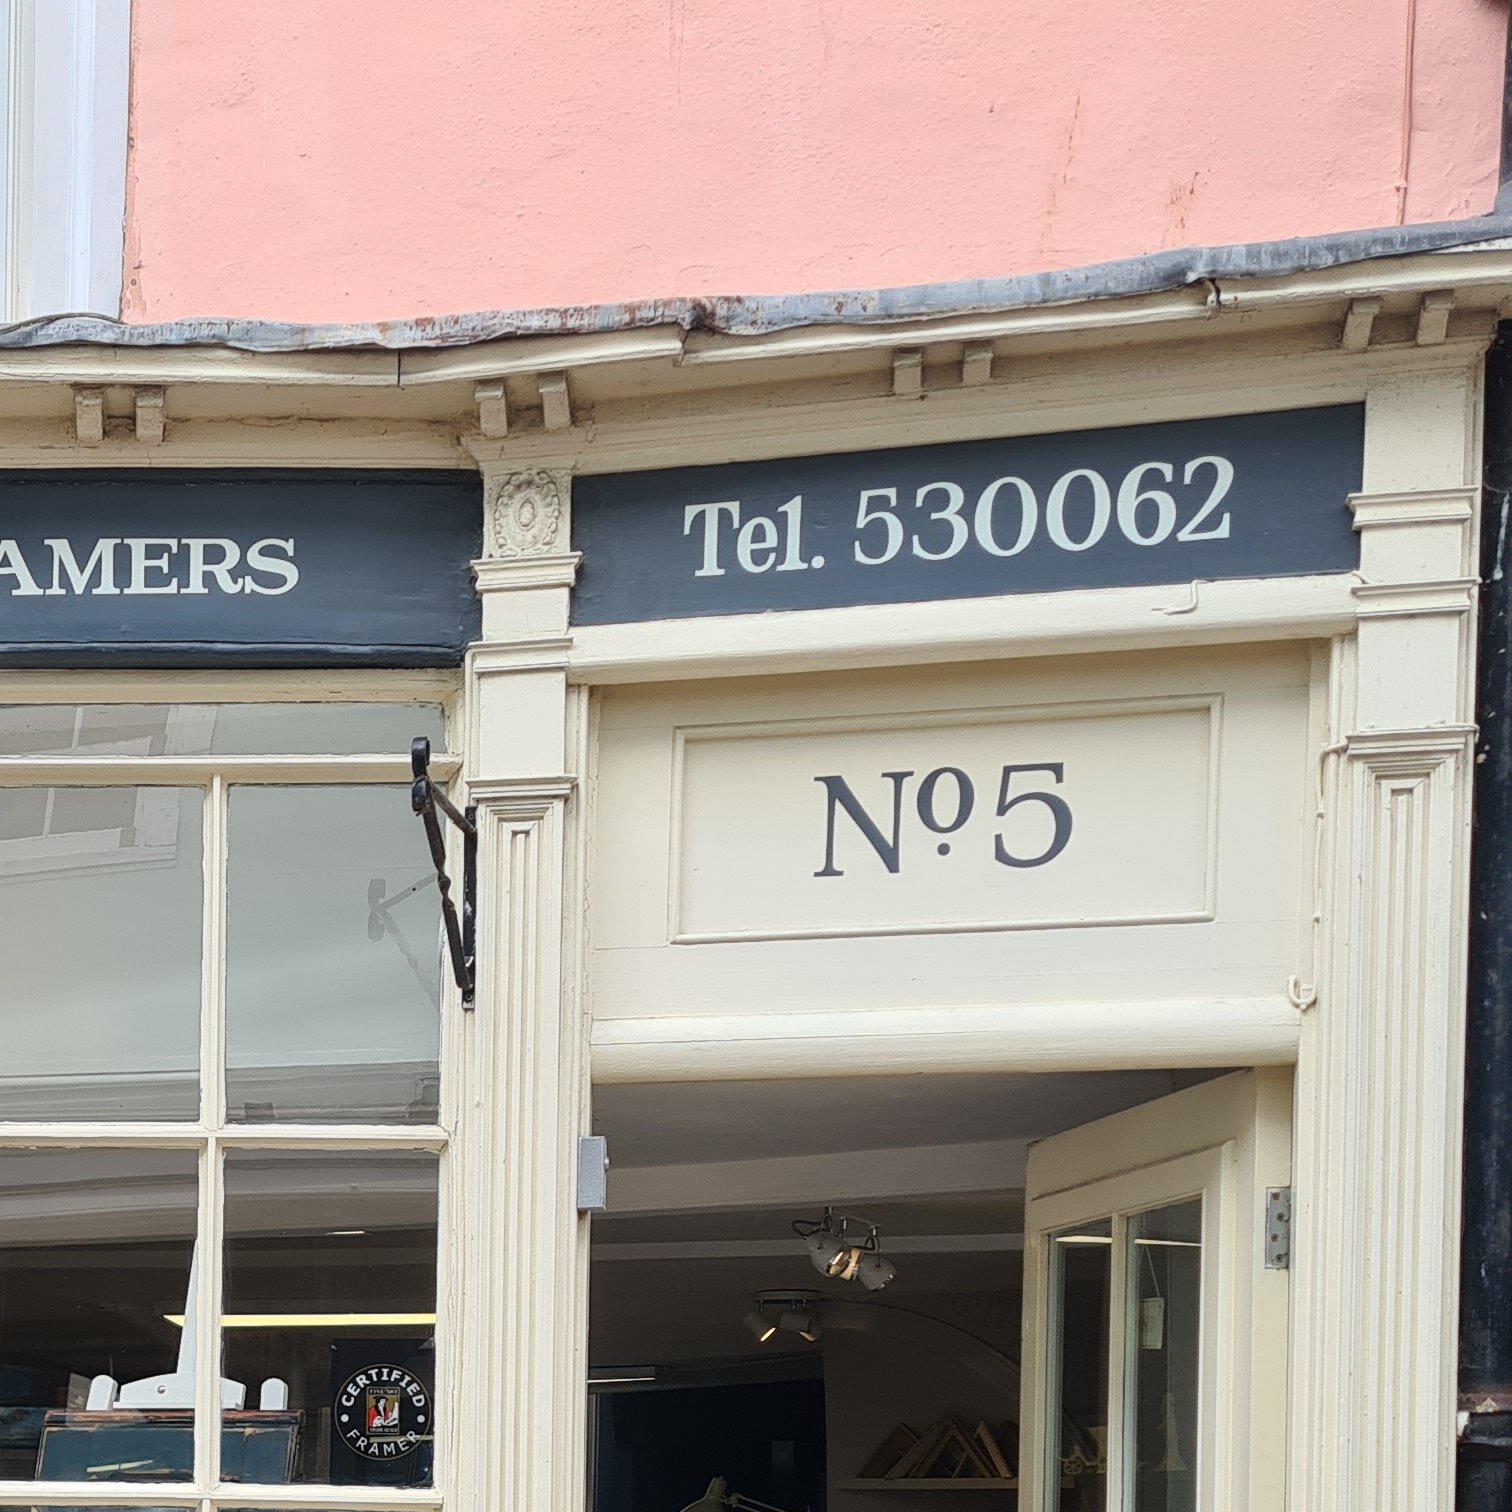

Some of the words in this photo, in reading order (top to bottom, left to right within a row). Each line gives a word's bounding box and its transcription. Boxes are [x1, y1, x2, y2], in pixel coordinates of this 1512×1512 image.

[683, 494, 826, 577] Tel.
[853, 455, 1236, 565] 530062
[341, 1368, 425, 1406] CERTIFIED
[346, 1428, 421, 1457] FRAMER
